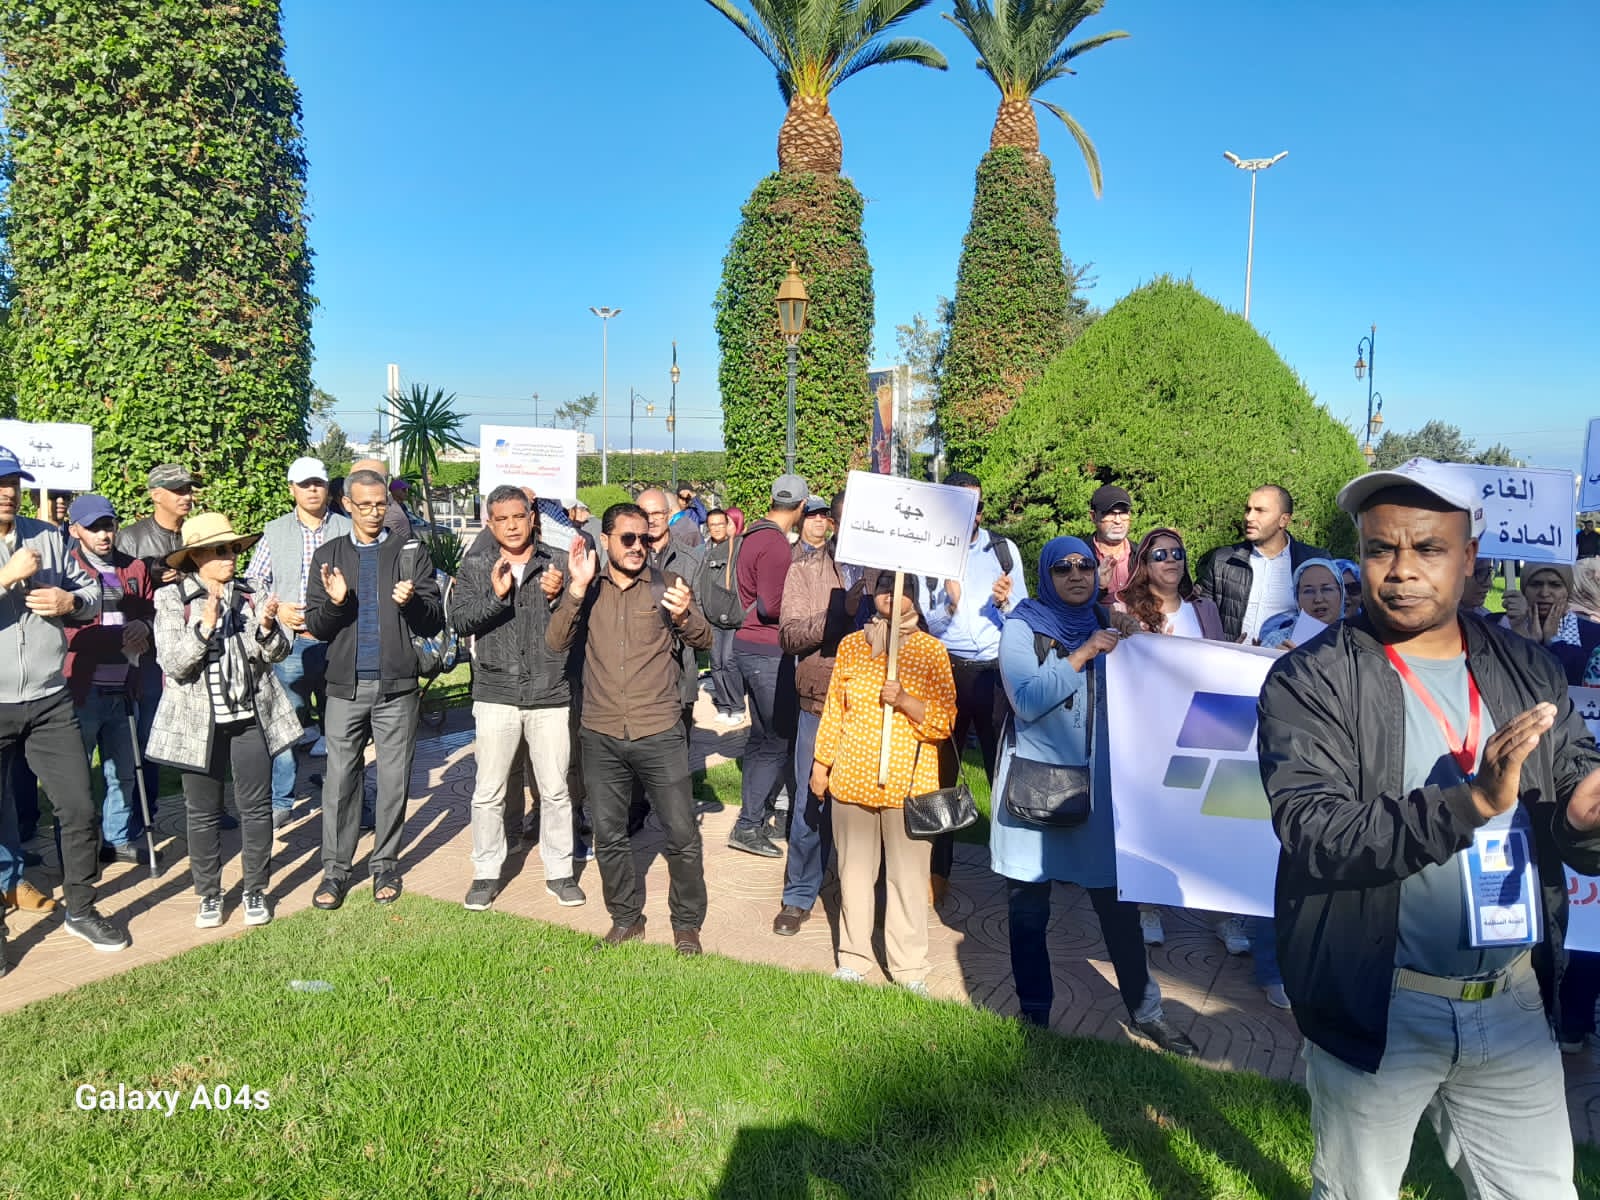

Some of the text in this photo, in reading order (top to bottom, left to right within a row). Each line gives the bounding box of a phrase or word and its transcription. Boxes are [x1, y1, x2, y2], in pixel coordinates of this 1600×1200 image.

[29, 436, 53, 453] جهة
[50, 456, 80, 473] درعة
[1482, 477, 1534, 509] إلغاء
[894, 497, 925, 521] جهة
[850, 519, 960, 548] الدار البيضاء سطات
[1499, 521, 1562, 548] المادة
